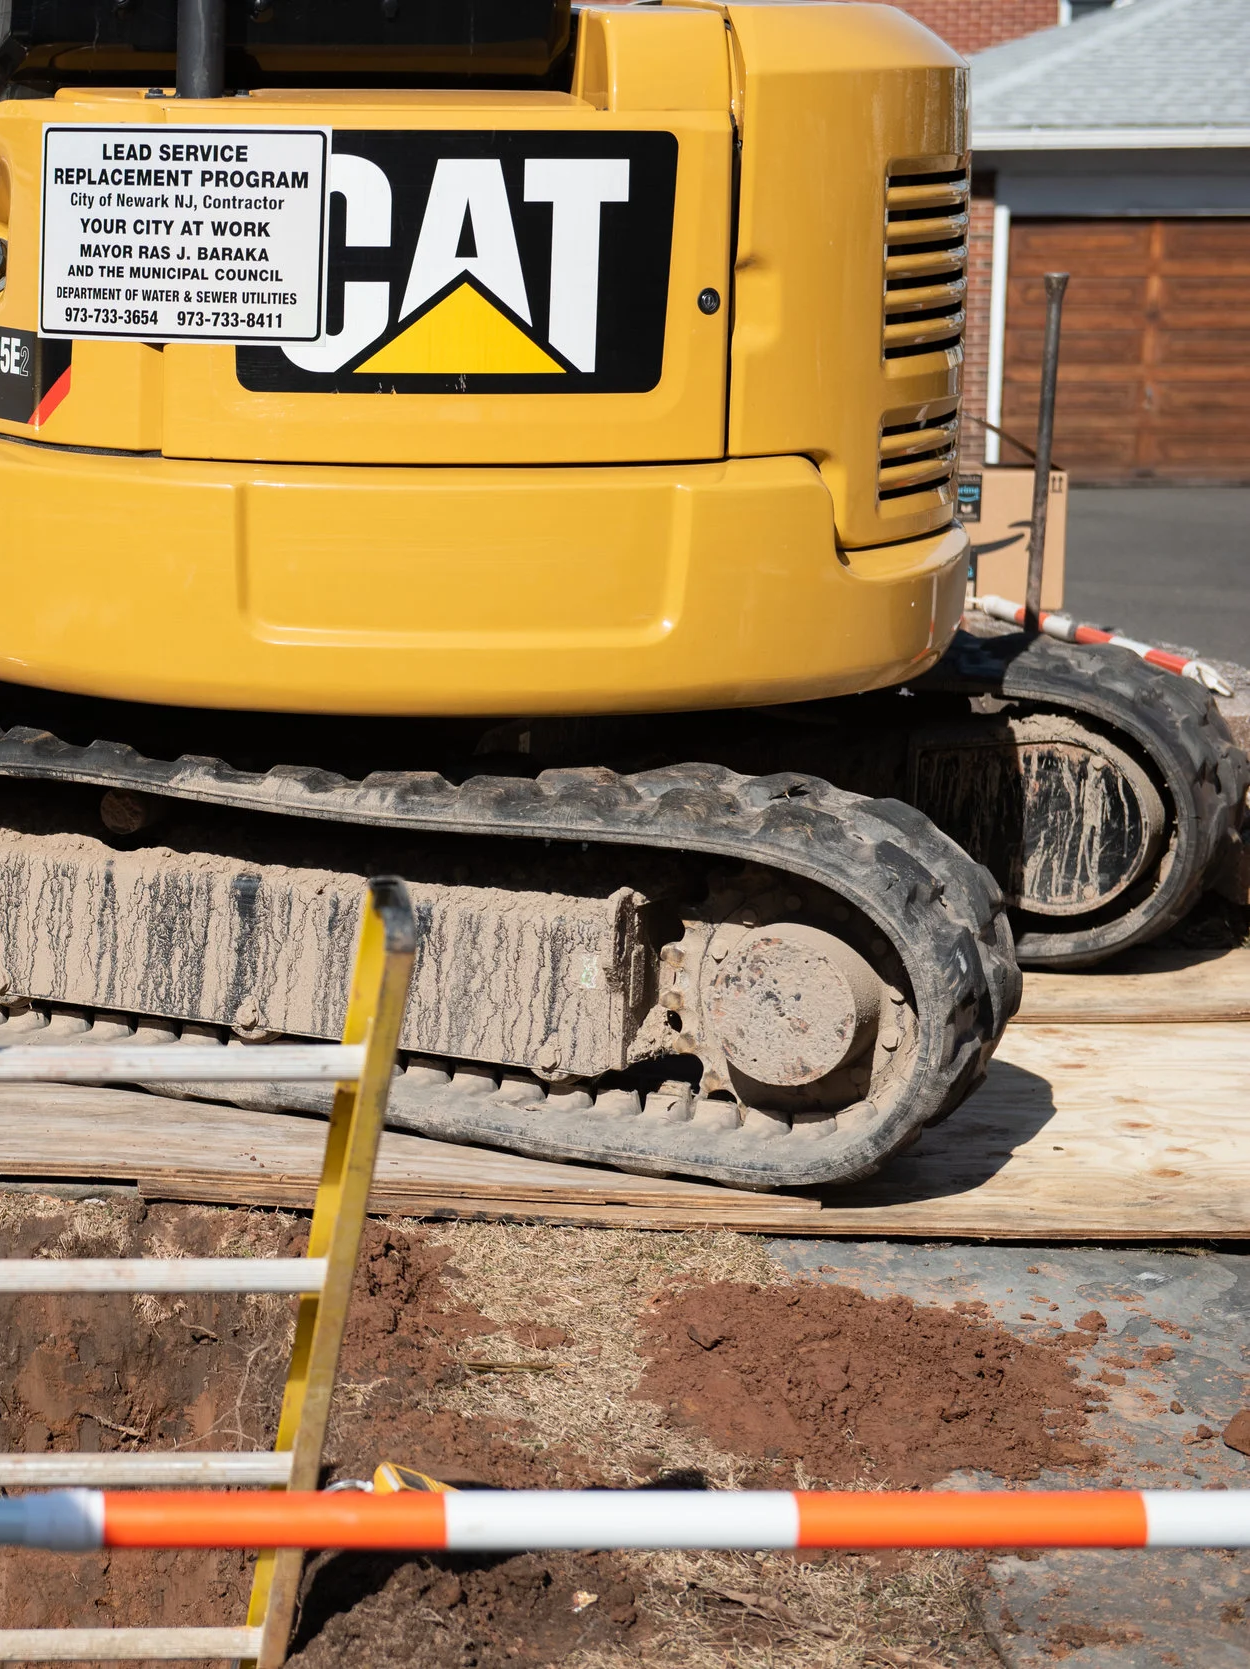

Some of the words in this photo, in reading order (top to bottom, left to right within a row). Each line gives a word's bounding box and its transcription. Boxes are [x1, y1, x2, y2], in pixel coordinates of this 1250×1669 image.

[103, 144, 151, 160] LEAD
[159, 144, 248, 162] SERVICE
[55, 168, 192, 186] REPLACEMENT
[201, 170, 308, 188] PROGRAM
[71, 192, 94, 209] City
[99, 193, 112, 206] of
[117, 194, 169, 207] Newark
[175, 195, 197, 211] NJ,
[203, 195, 284, 209] Contractor
[81, 218, 126, 234] YOUR
[133, 219, 174, 235] CITY
[181, 221, 203, 235] AT
[211, 221, 270, 237] WORK
[80, 244, 132, 258] MAYOR
[139, 246, 170, 259] RAS
[177, 247, 190, 260] J.
[198, 247, 269, 261] BARAKA
[280, 153, 630, 373] CAT
[68, 265, 93, 277] AND
[99, 266, 124, 278] THE
[130, 267, 208, 280] MUNICIPAL
[215, 269, 283, 281] COUNCIL
[57, 287, 121, 300] DEPARTMENT
[125, 289, 138, 300] OF
[142, 290, 179, 302] WATER
[184, 291, 192, 302] &
[197, 291, 237, 303] SEWER
[242, 292, 296, 305] UTILITIES
[65, 307, 158, 325] 973-733-3654
[178, 311, 281, 328] 973-733-8411
